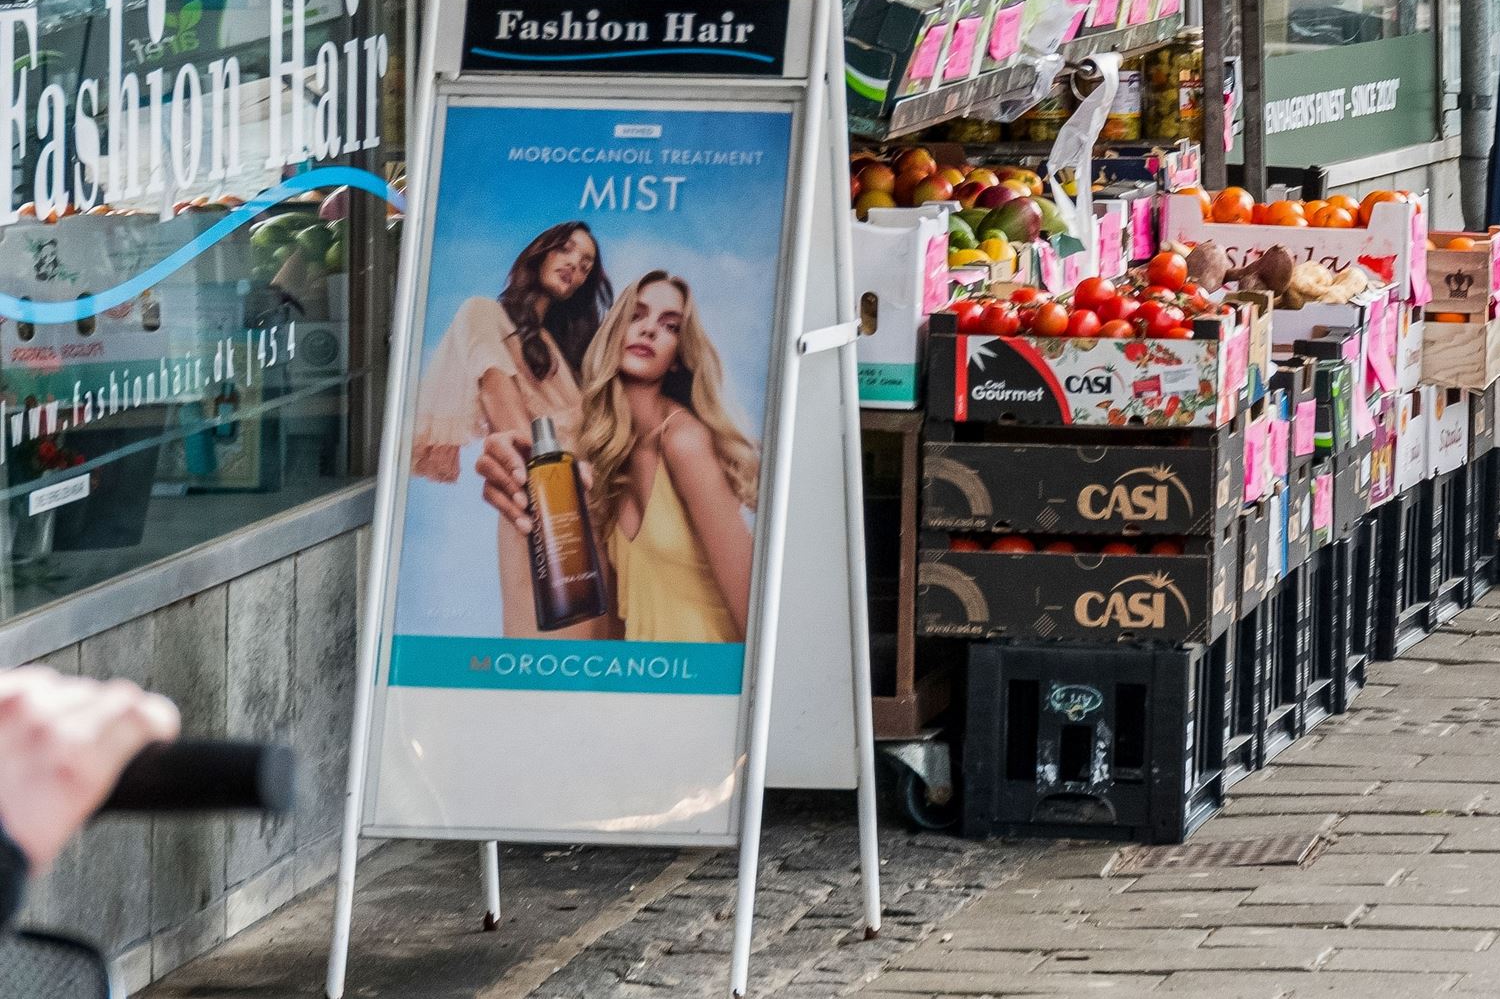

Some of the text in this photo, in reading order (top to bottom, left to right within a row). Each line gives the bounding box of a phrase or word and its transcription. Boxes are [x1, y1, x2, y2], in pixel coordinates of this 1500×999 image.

[495, 8, 756, 44] Fashion Hair
[507, 146, 764, 166] MOROCCANOIL TREATMENT
[578, 174, 687, 212] MIST
[971, 385, 1046, 402] Gourmet
[1065, 375, 1112, 394] CASI
[1077, 483, 1169, 521] CASI
[1074, 590, 1166, 629] CASI
